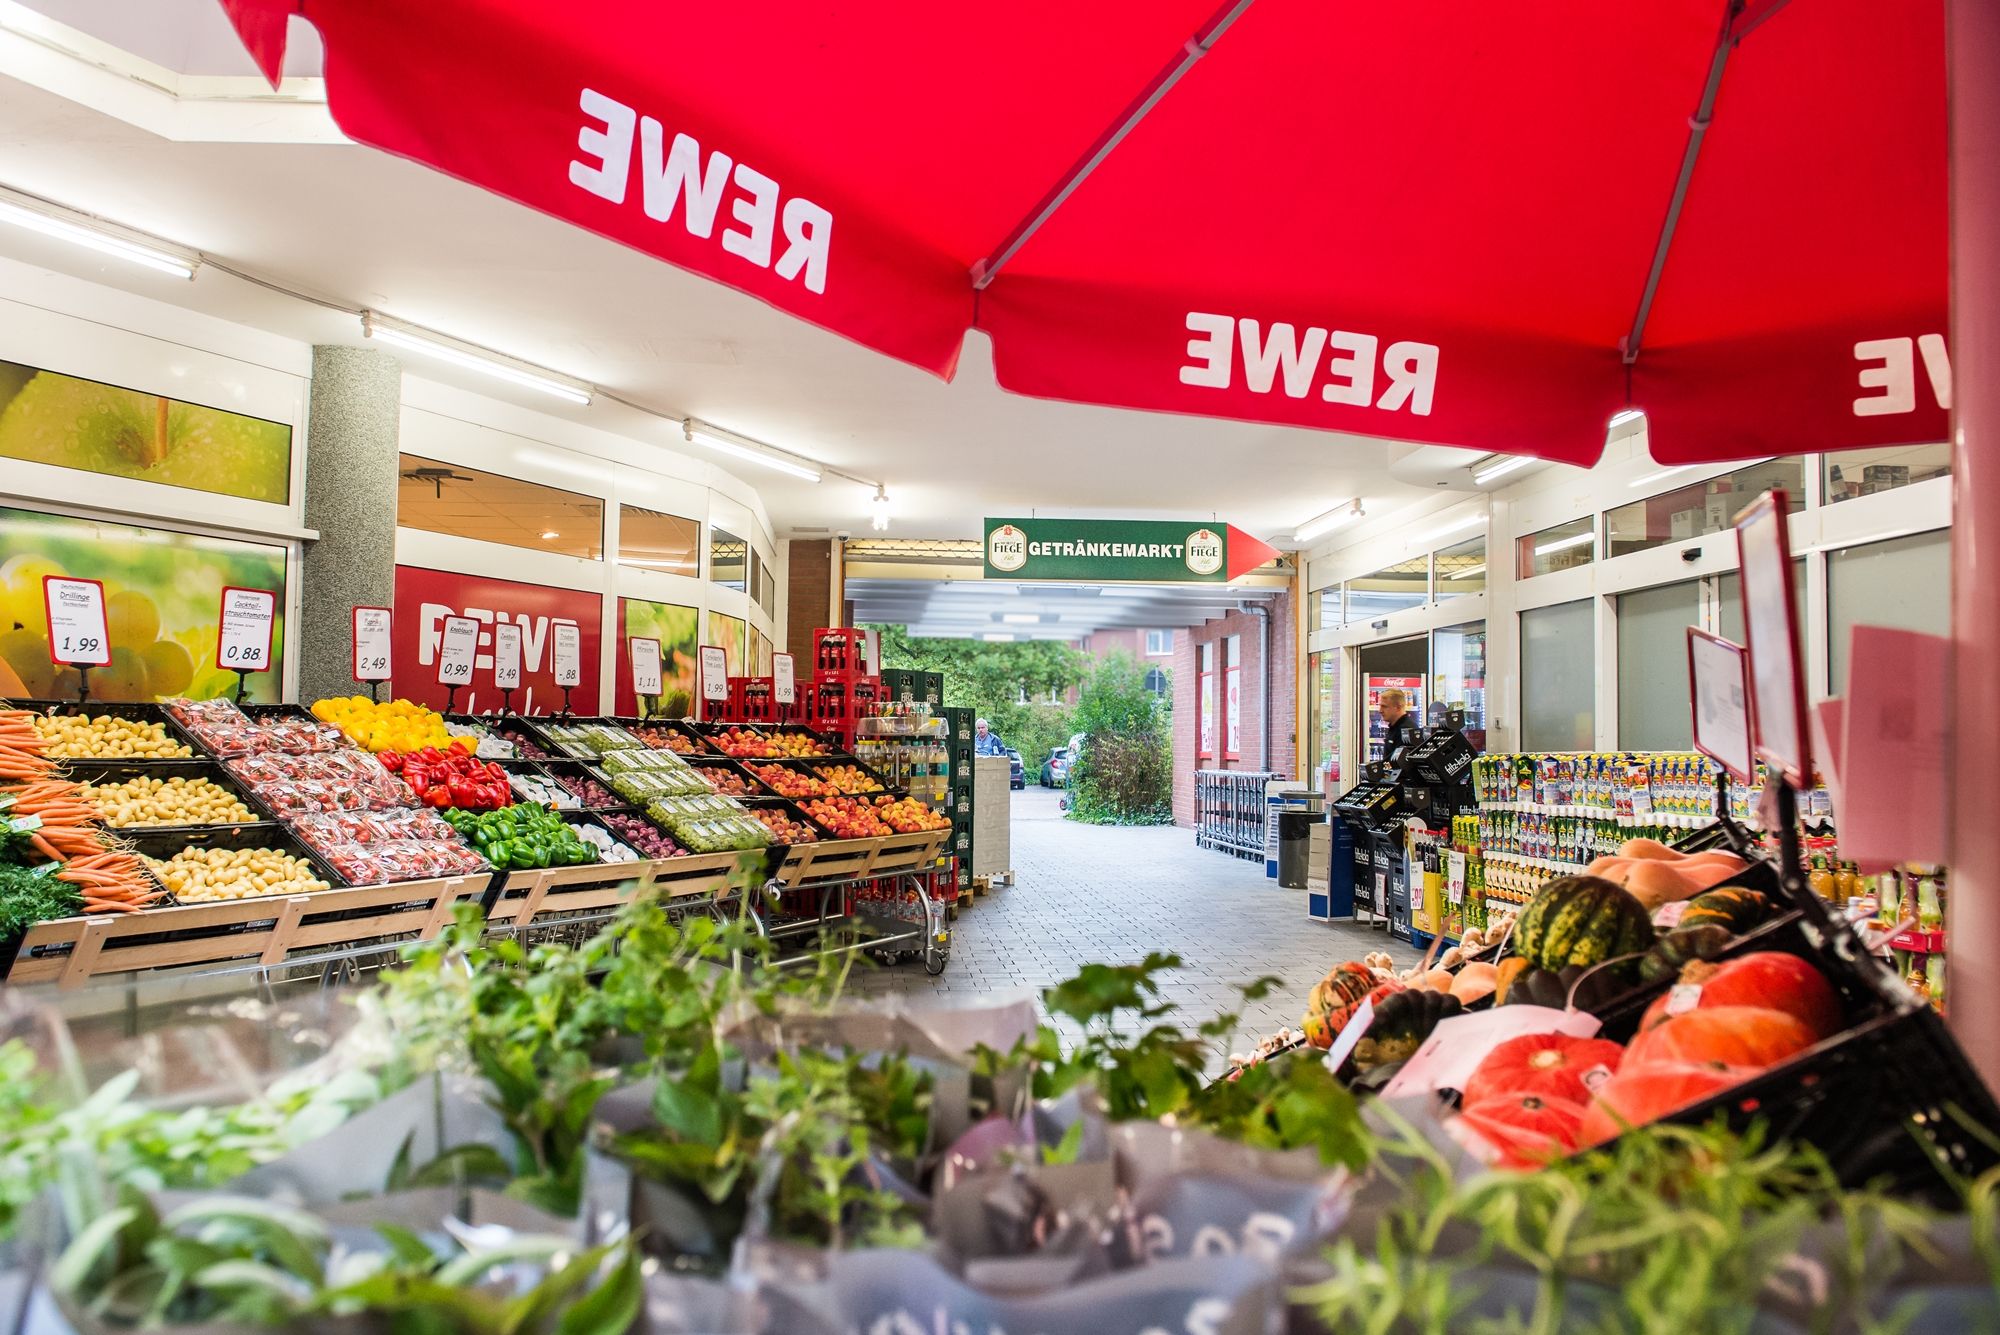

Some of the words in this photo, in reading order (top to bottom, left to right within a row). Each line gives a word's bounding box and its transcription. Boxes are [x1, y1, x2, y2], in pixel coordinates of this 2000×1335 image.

[994, 542, 1022, 553] FIEGE
[1028, 539, 1184, 558] GETRÄNKEMARKT
[1191, 546, 1218, 557] FIEGE
[60, 591, 91, 602] Drillinge
[1444, 749, 1472, 776] fritz-kola
